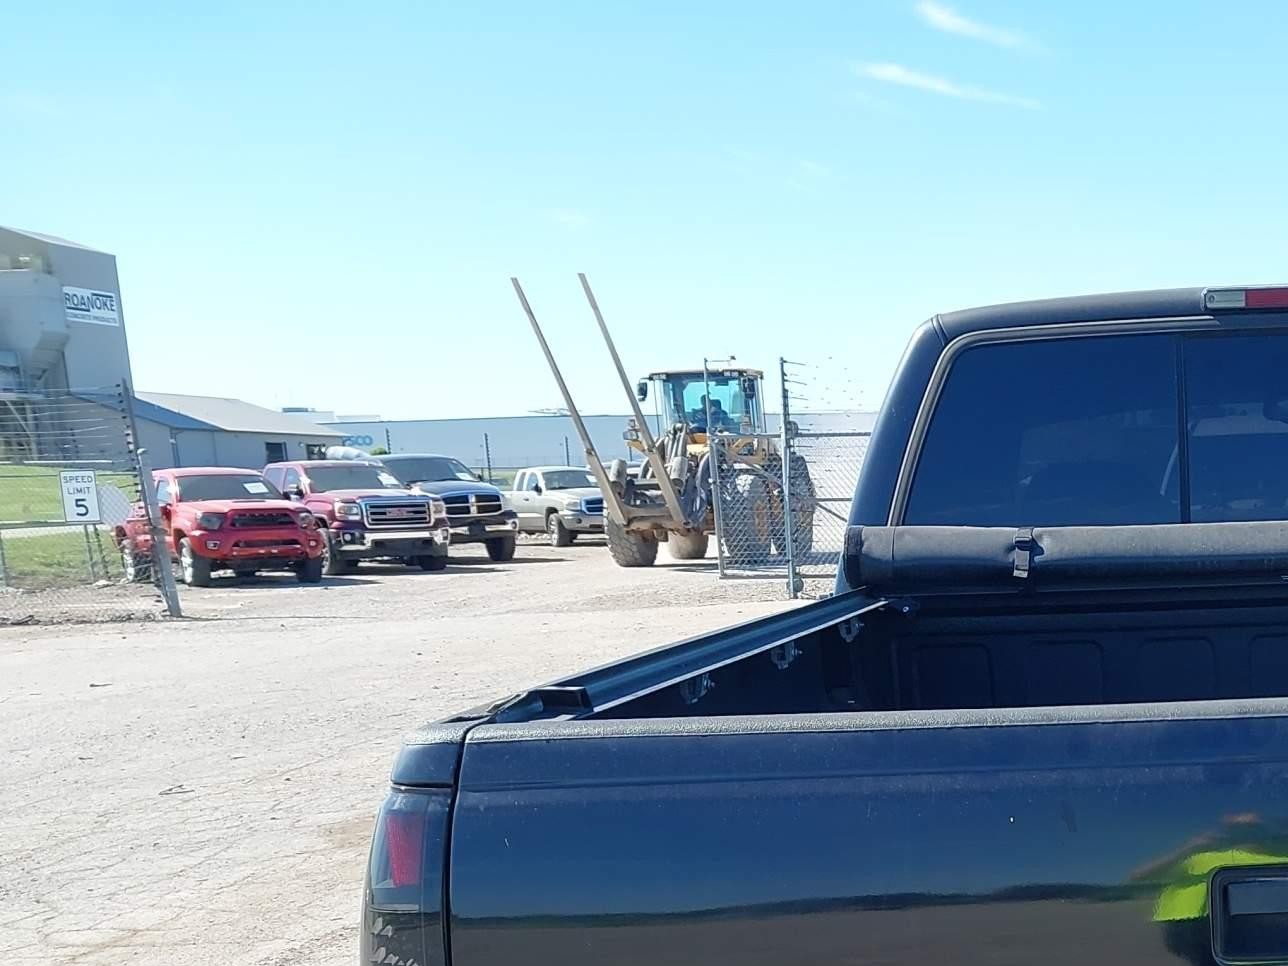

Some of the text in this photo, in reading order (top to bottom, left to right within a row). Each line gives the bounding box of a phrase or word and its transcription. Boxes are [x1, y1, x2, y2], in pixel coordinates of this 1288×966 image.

[64, 293, 115, 312] ROANOKE
[63, 475, 93, 484] SPEED
[67, 487, 91, 495] LIMIT
[75, 498, 89, 517] 5
